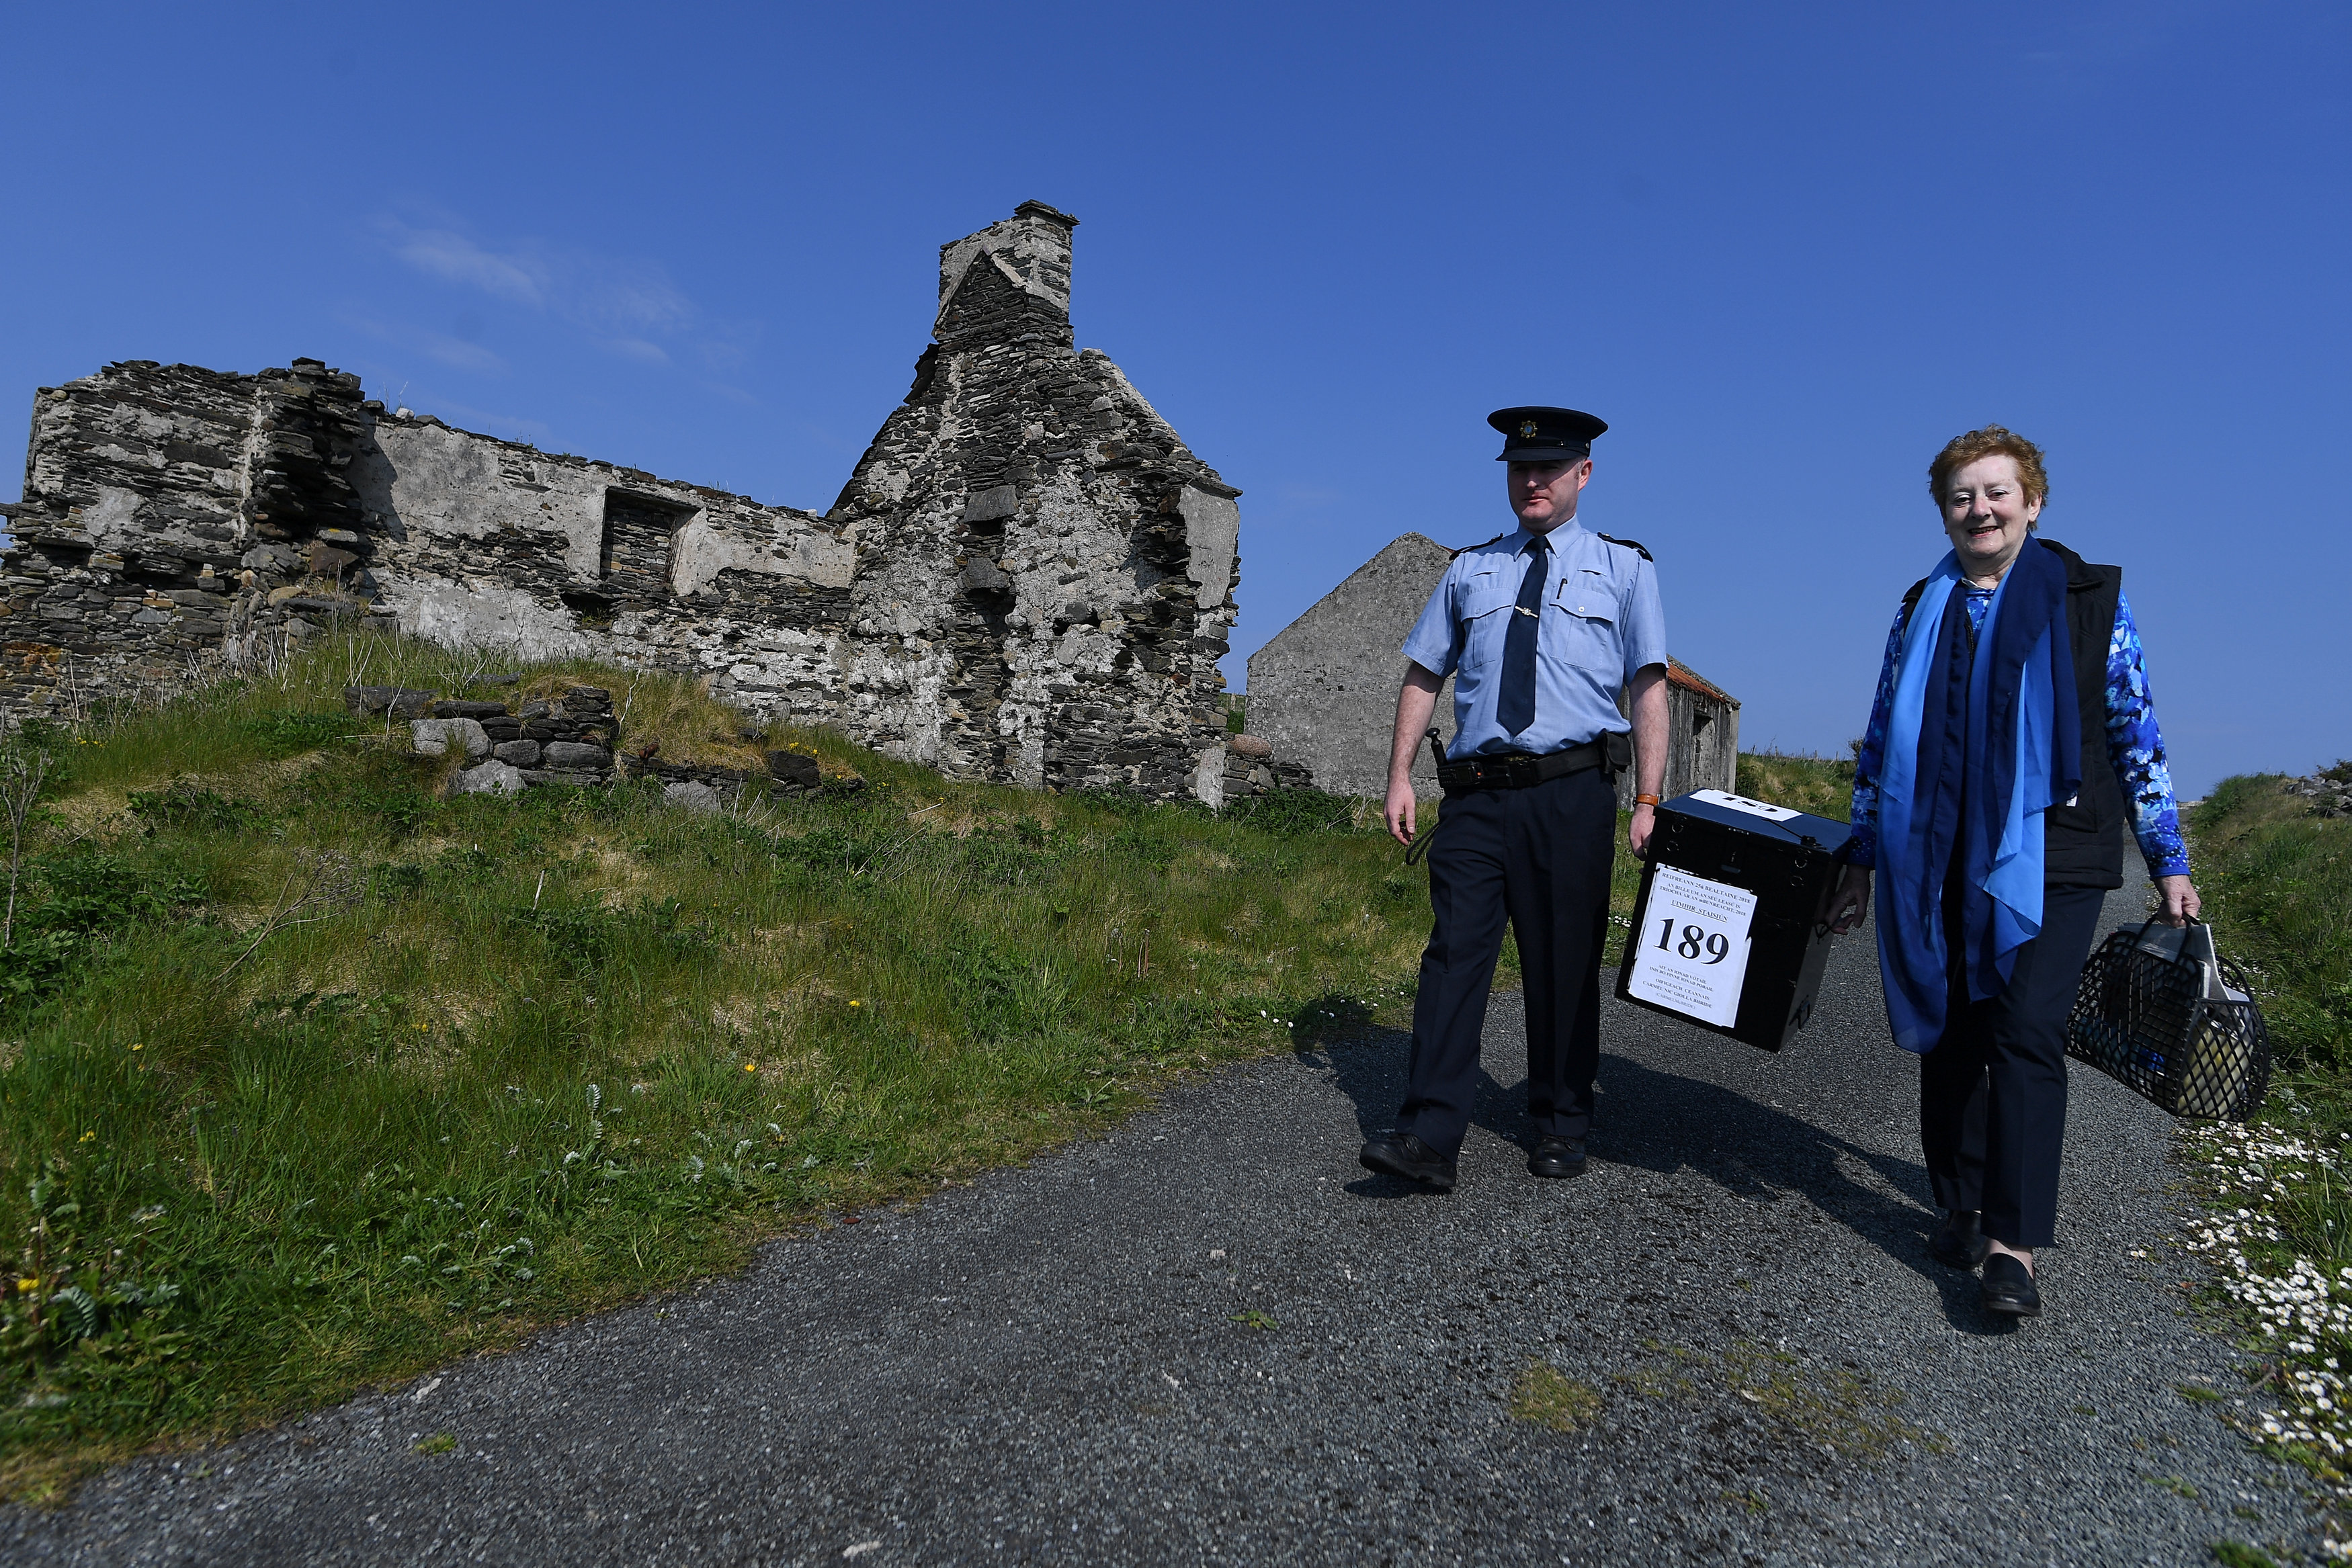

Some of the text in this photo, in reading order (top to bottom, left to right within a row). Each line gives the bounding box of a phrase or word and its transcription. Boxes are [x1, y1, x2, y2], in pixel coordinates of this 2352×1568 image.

[1722, 797, 1778, 812] 189
[1661, 872, 1693, 886] REIFREANN
[1704, 885, 1737, 900] BEALTAINE
[1671, 900, 1728, 922] UIMHIR STAISIÚN
[1654, 918, 1728, 964] 189
[1666, 972, 1680, 980] FINNE
[1680, 977, 1695, 986] IONAD
[1673, 969, 1689, 978] IONAD
[1642, 980, 1663, 991] CARMEL
[1673, 991, 1692, 1002] GIOLLA
[1654, 977, 1710, 1000] OIFIGEACH CEANNAIS
